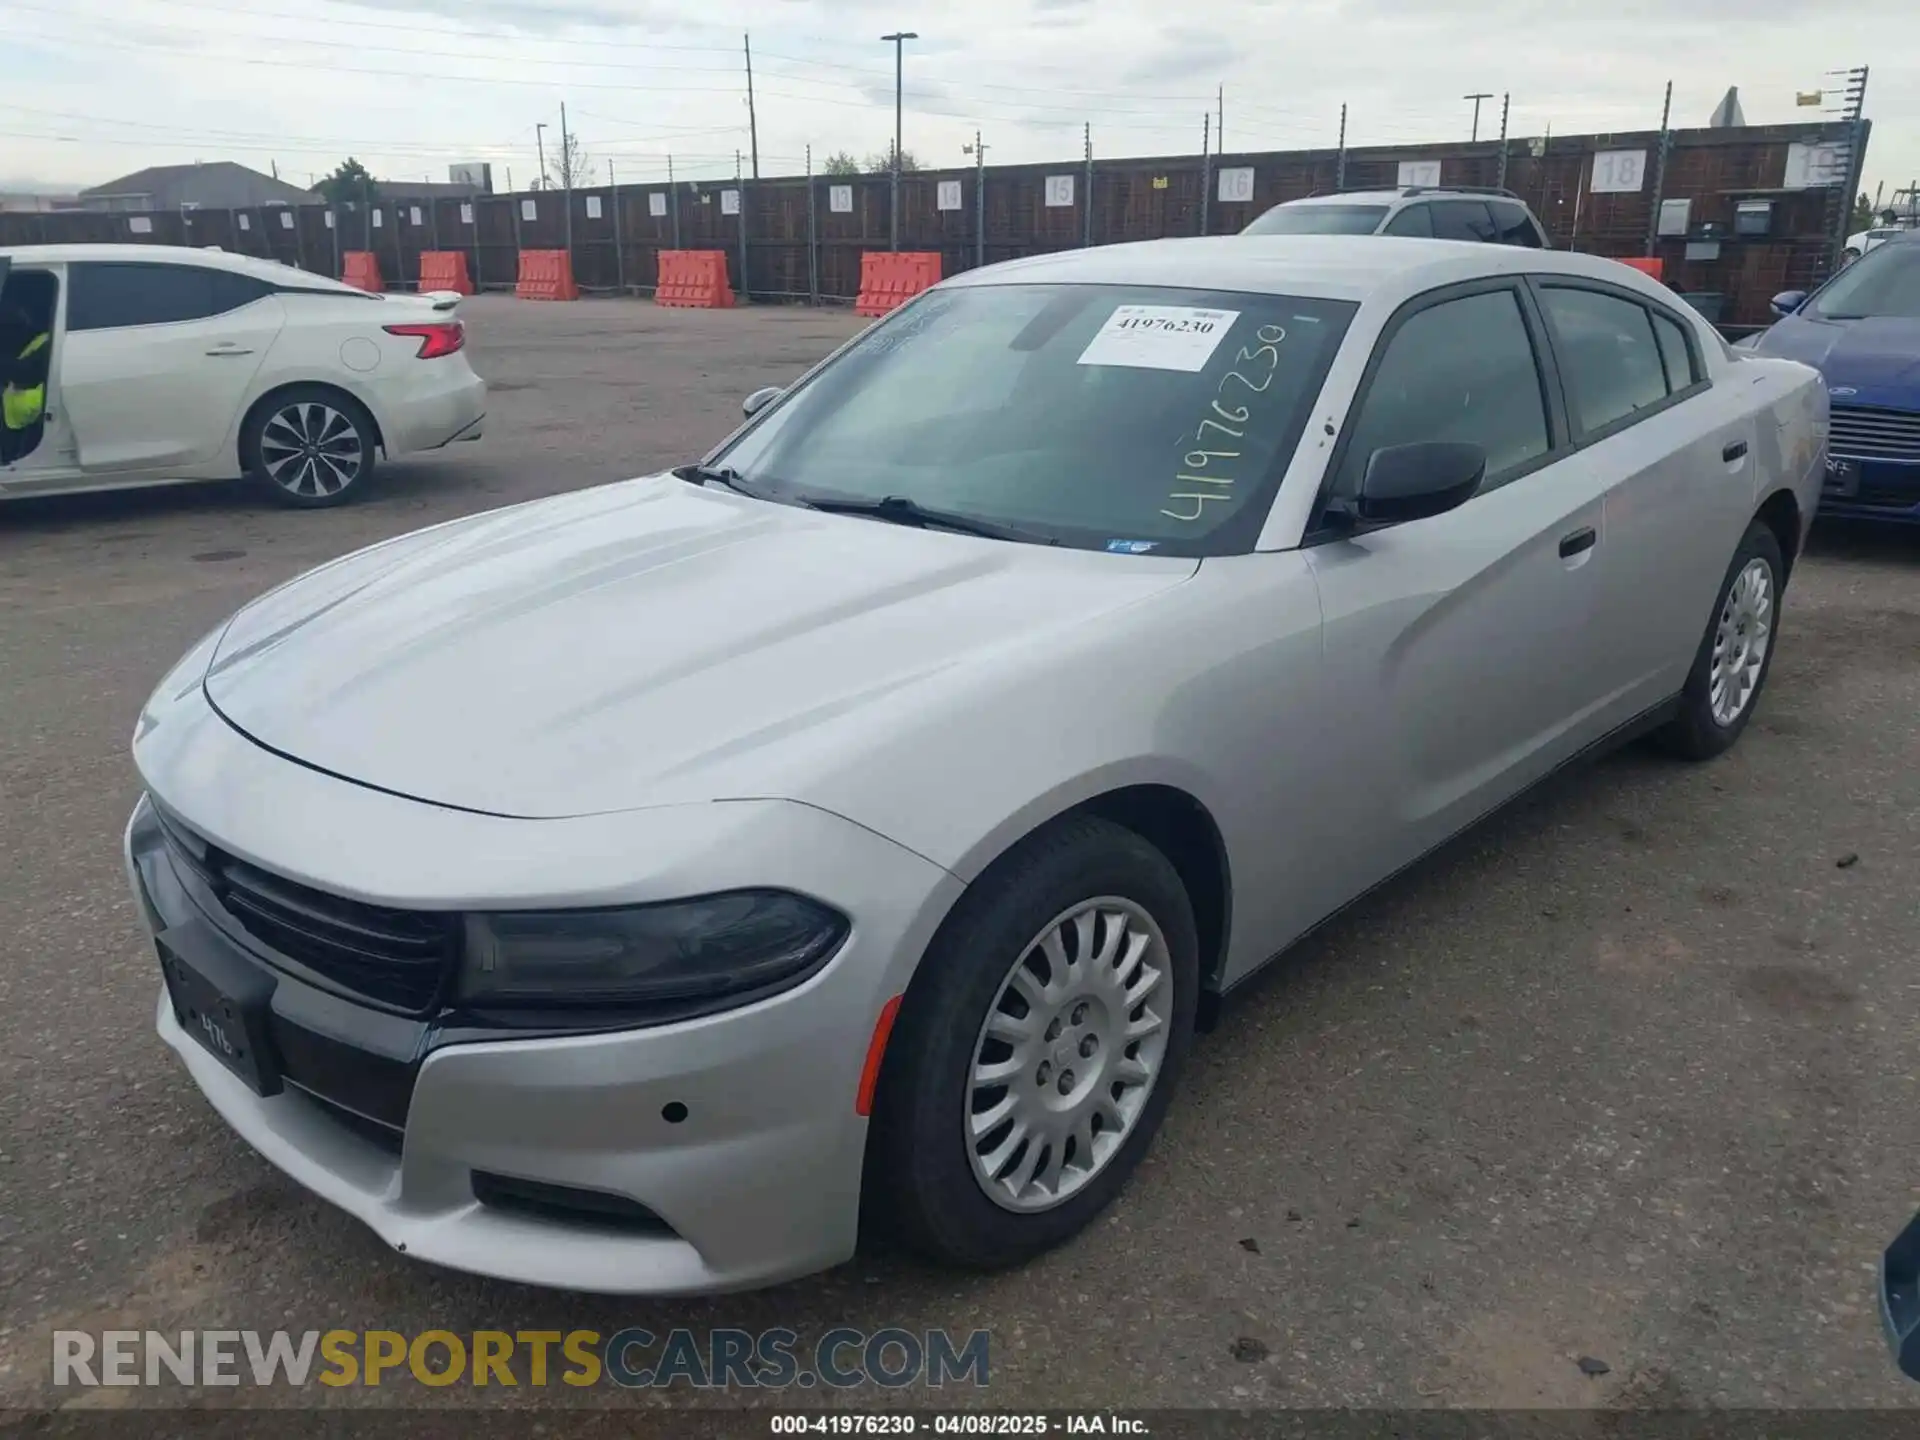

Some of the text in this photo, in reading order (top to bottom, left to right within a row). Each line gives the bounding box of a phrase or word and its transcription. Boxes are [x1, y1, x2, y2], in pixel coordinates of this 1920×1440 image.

[1603, 153, 1636, 185] 18
[835, 188, 850, 209] 13
[1050, 178, 1070, 202] 15
[1117, 318, 1215, 334] 41976230
[1159, 324, 1286, 521] 41976230
